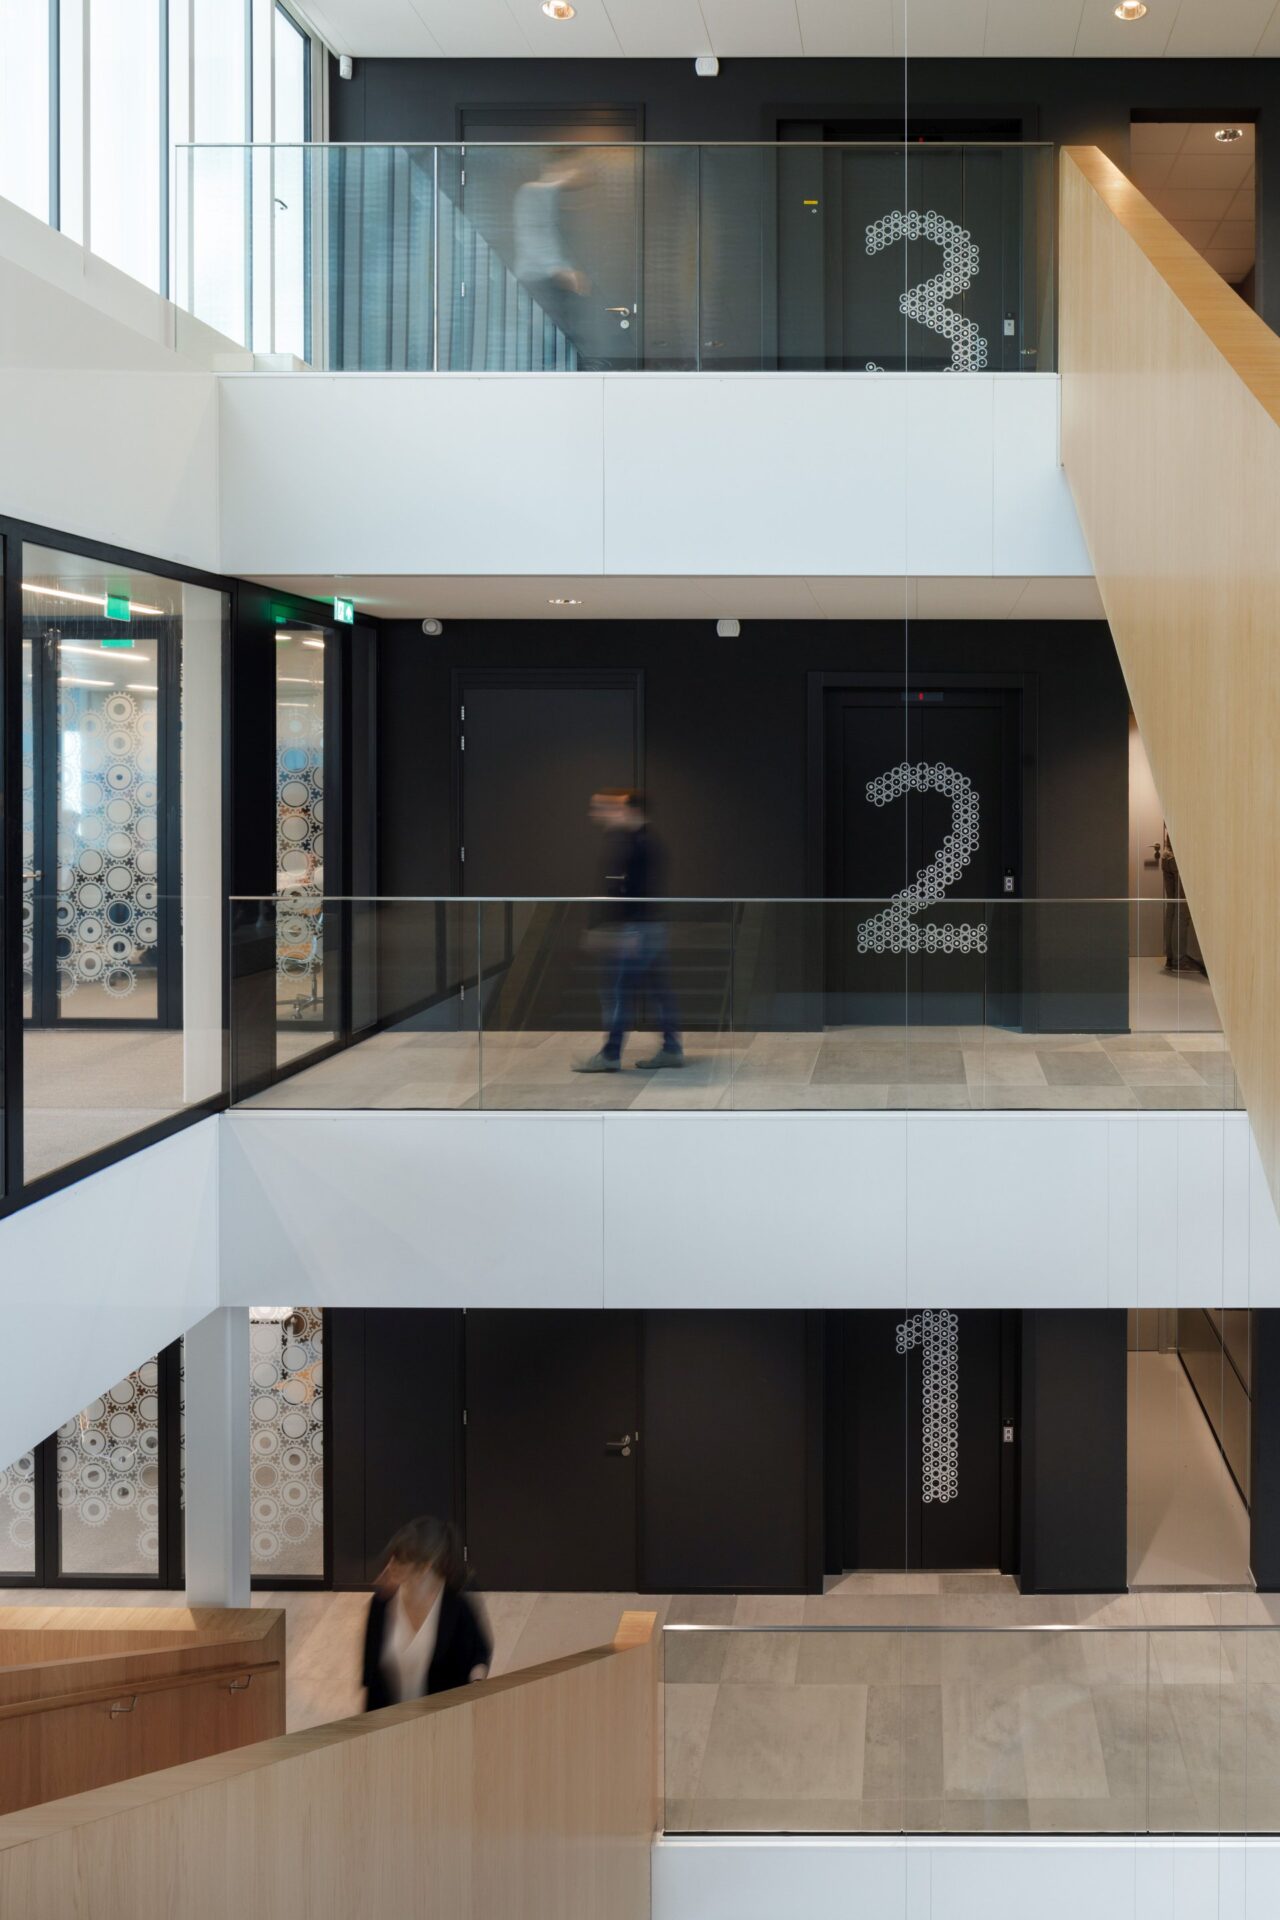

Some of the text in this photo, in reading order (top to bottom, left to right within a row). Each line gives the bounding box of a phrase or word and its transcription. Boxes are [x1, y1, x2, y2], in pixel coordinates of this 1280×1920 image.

[866, 210, 987, 372] 3
[857, 762, 987, 953] 2
[896, 1309, 958, 1503] 1
